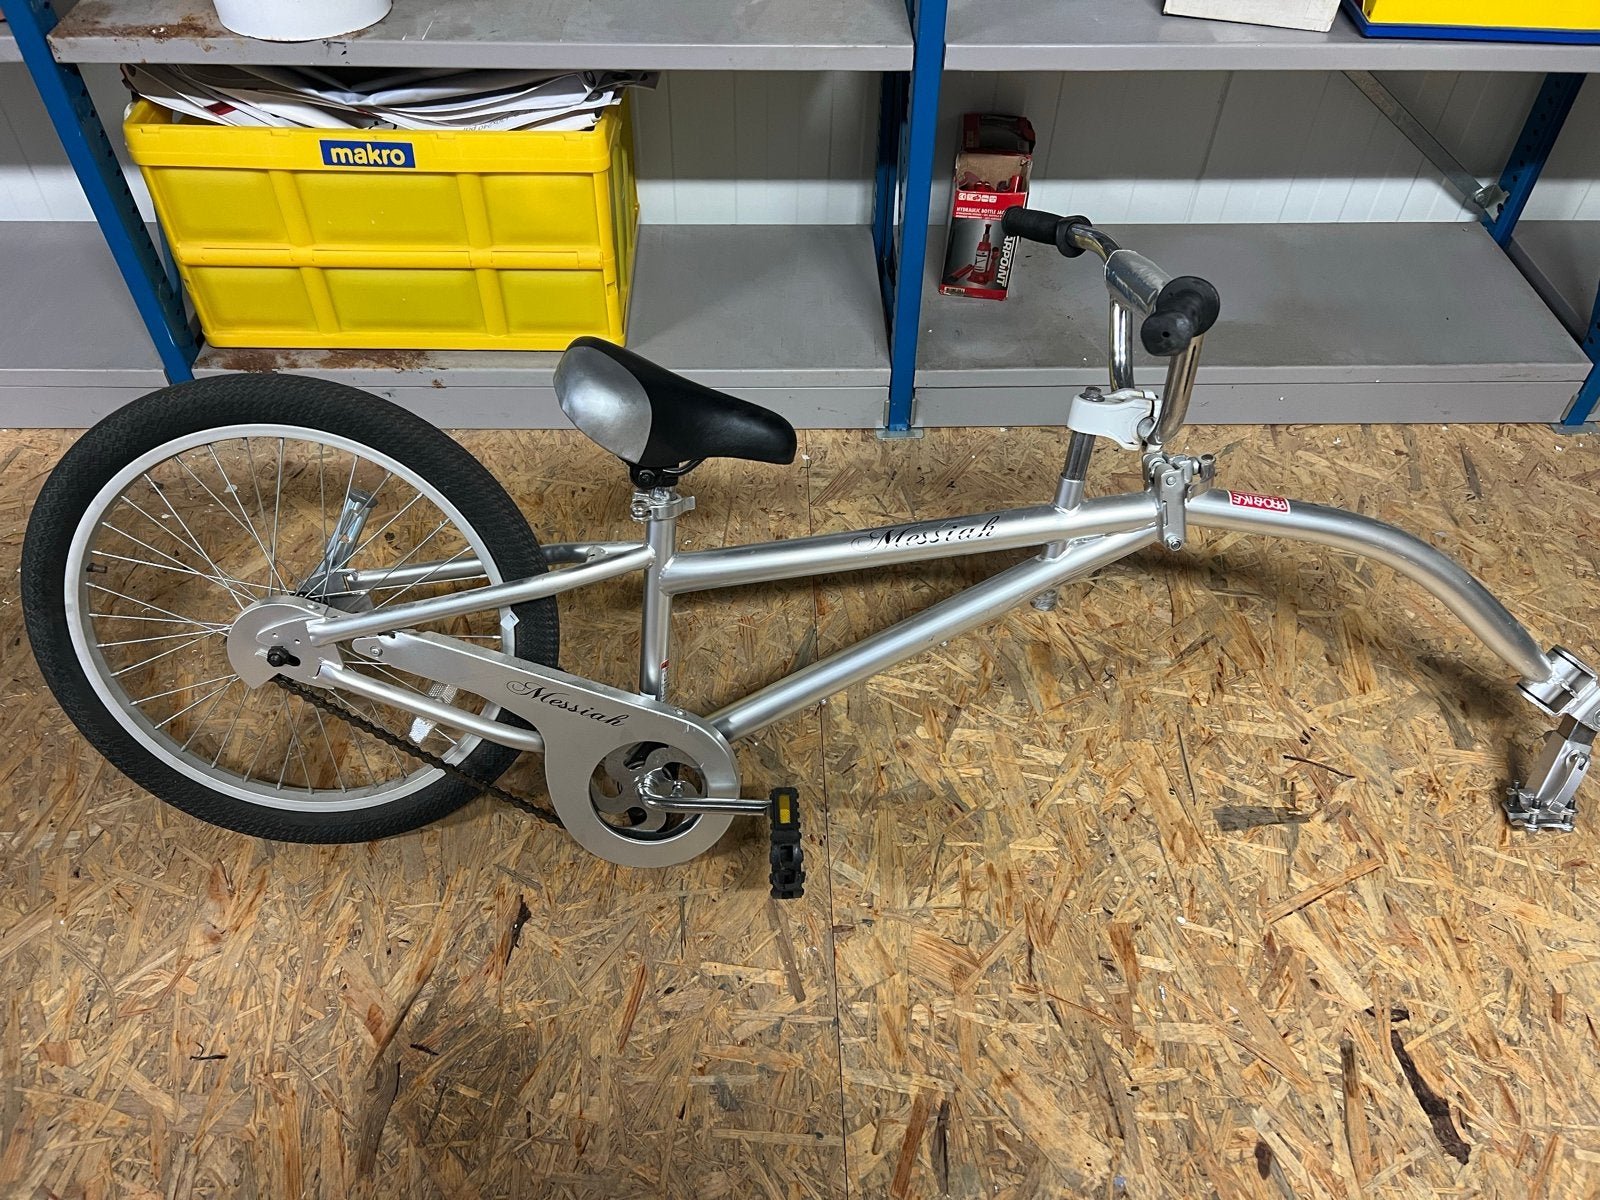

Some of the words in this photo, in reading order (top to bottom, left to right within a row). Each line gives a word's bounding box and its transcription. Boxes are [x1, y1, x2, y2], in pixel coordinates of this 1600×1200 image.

[330, 143, 405, 165] makro
[996, 235, 1014, 287] ARPOiNT
[850, 515, 1000, 550] Messiah
[506, 680, 629, 727] Messiah
